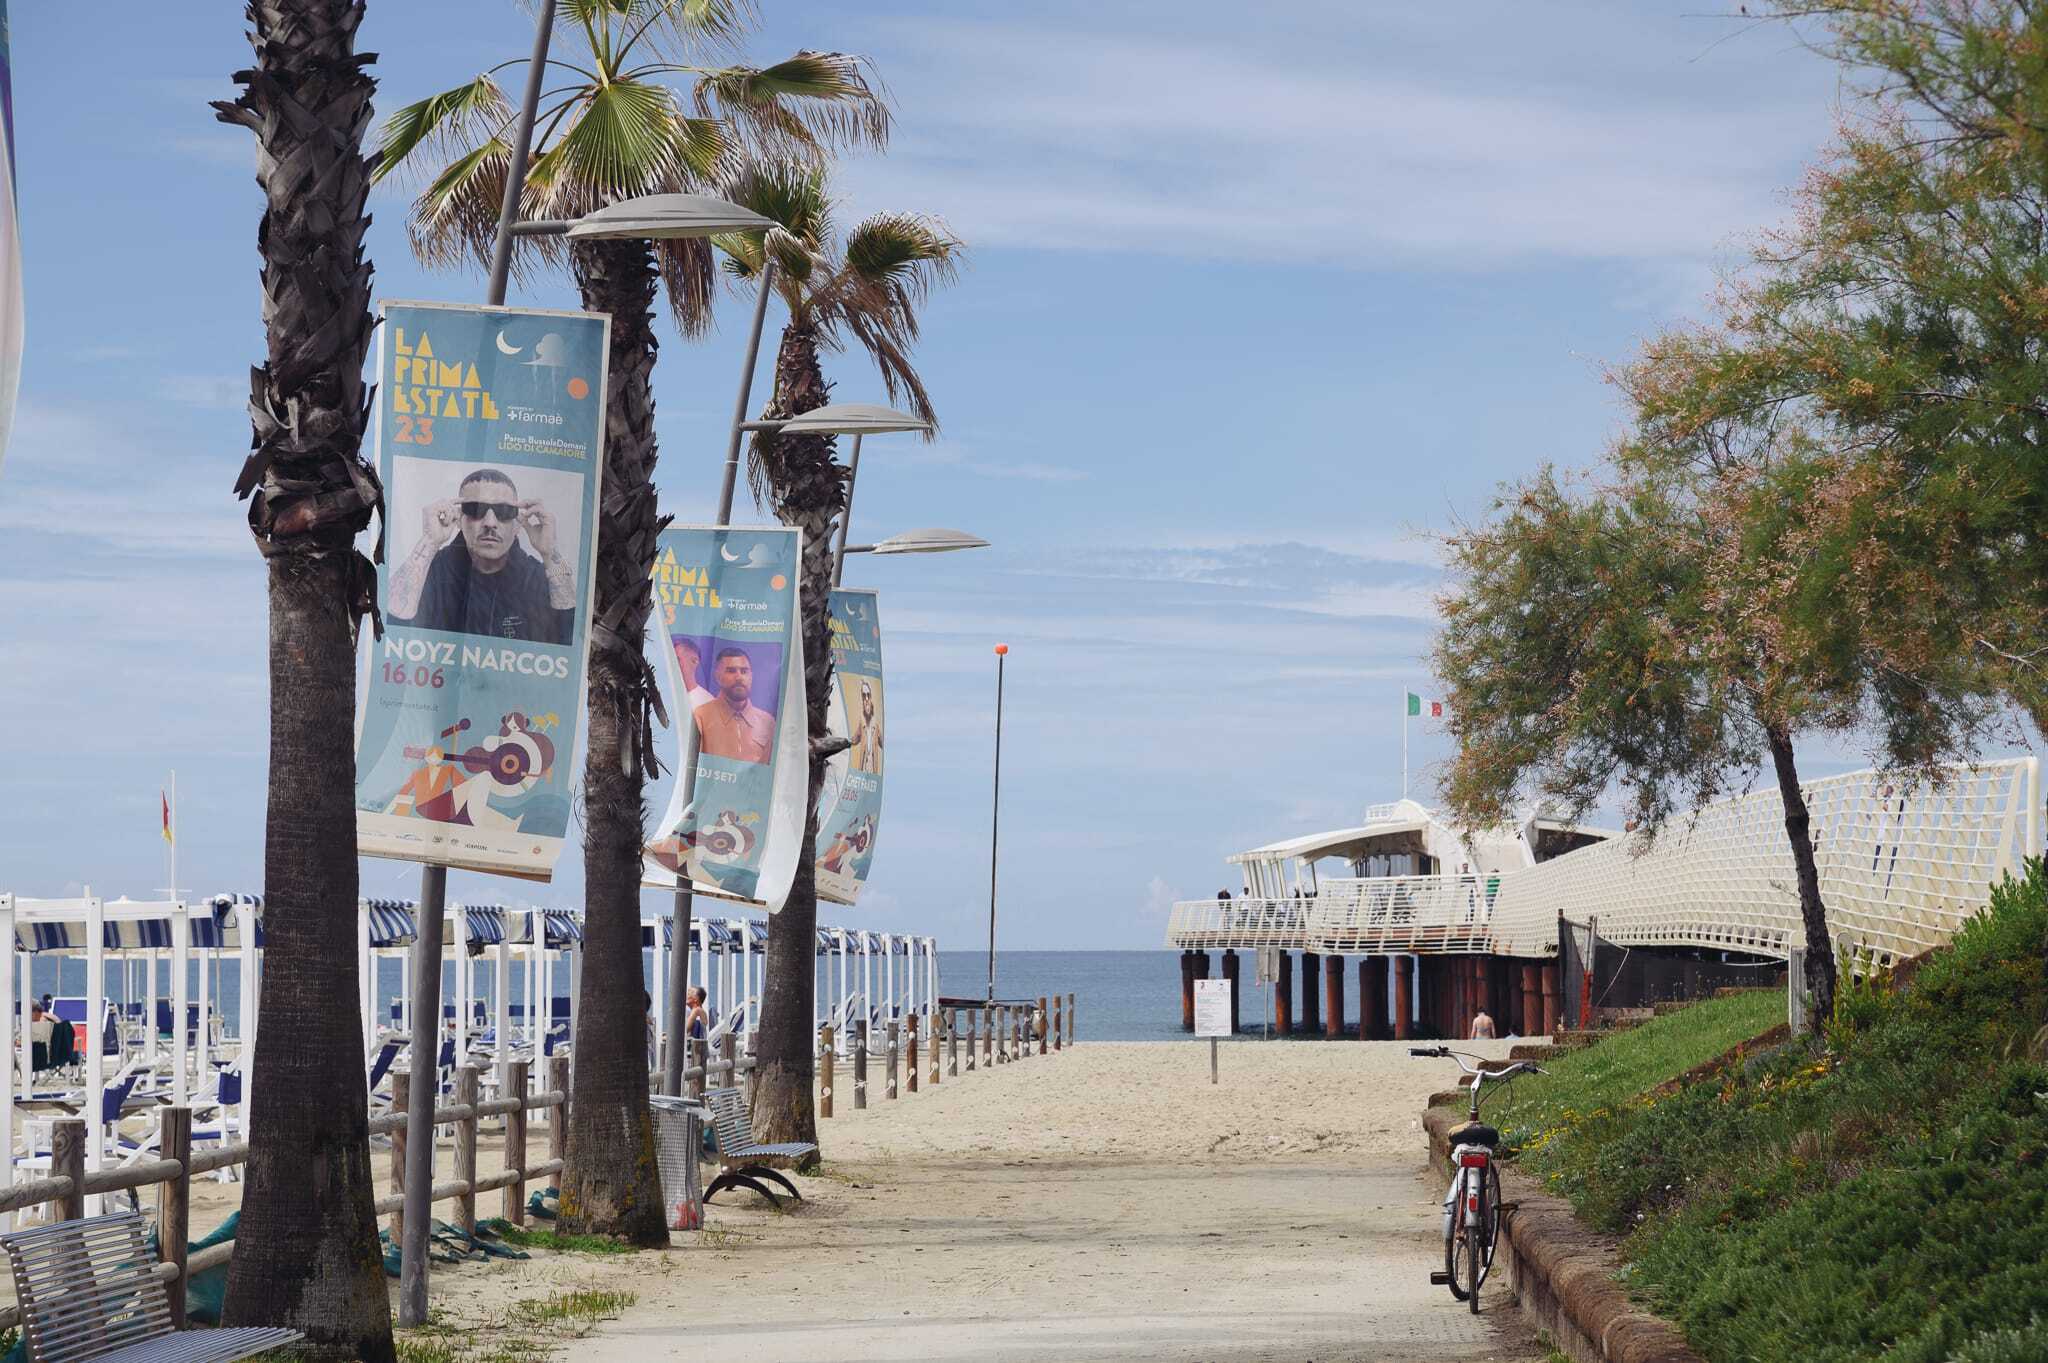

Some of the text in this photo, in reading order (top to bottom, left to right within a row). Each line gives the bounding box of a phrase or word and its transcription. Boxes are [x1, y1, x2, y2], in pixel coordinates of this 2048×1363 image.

[395, 327, 434, 358] LA
[395, 356, 482, 389] PRIMA
[394, 385, 500, 420] ESTATE
[393, 415, 433, 446] 23
[659, 583, 722, 609] STATE
[384, 637, 569, 679] NOYZ NARCOS
[382, 661, 445, 689] 16.06
